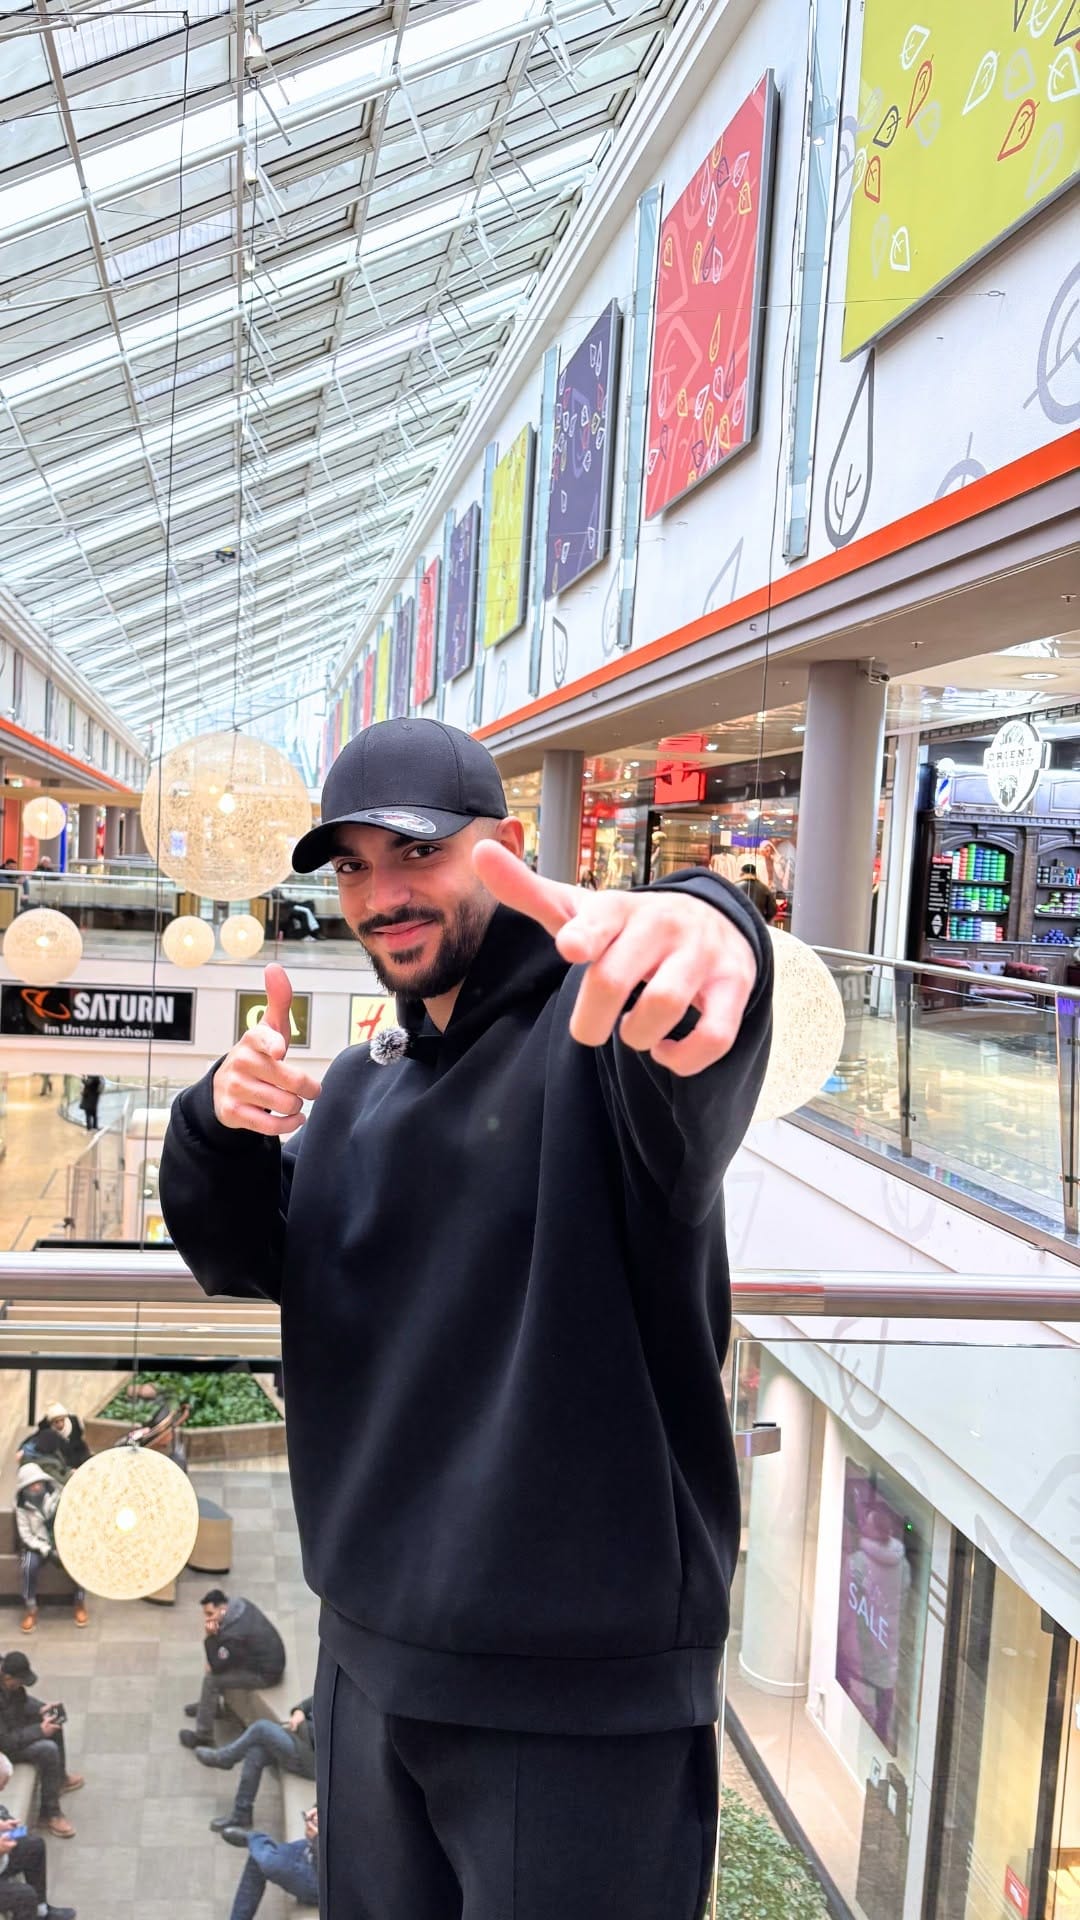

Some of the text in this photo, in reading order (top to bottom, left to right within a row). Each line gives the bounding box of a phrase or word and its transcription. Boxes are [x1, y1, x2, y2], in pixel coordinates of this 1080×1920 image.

[988, 748, 1033, 762] ORIENT
[73, 992, 175, 1023] SATURN
[44, 1023, 154, 1038] Im Untergeschoss
[848, 1582, 889, 1650] SALE
